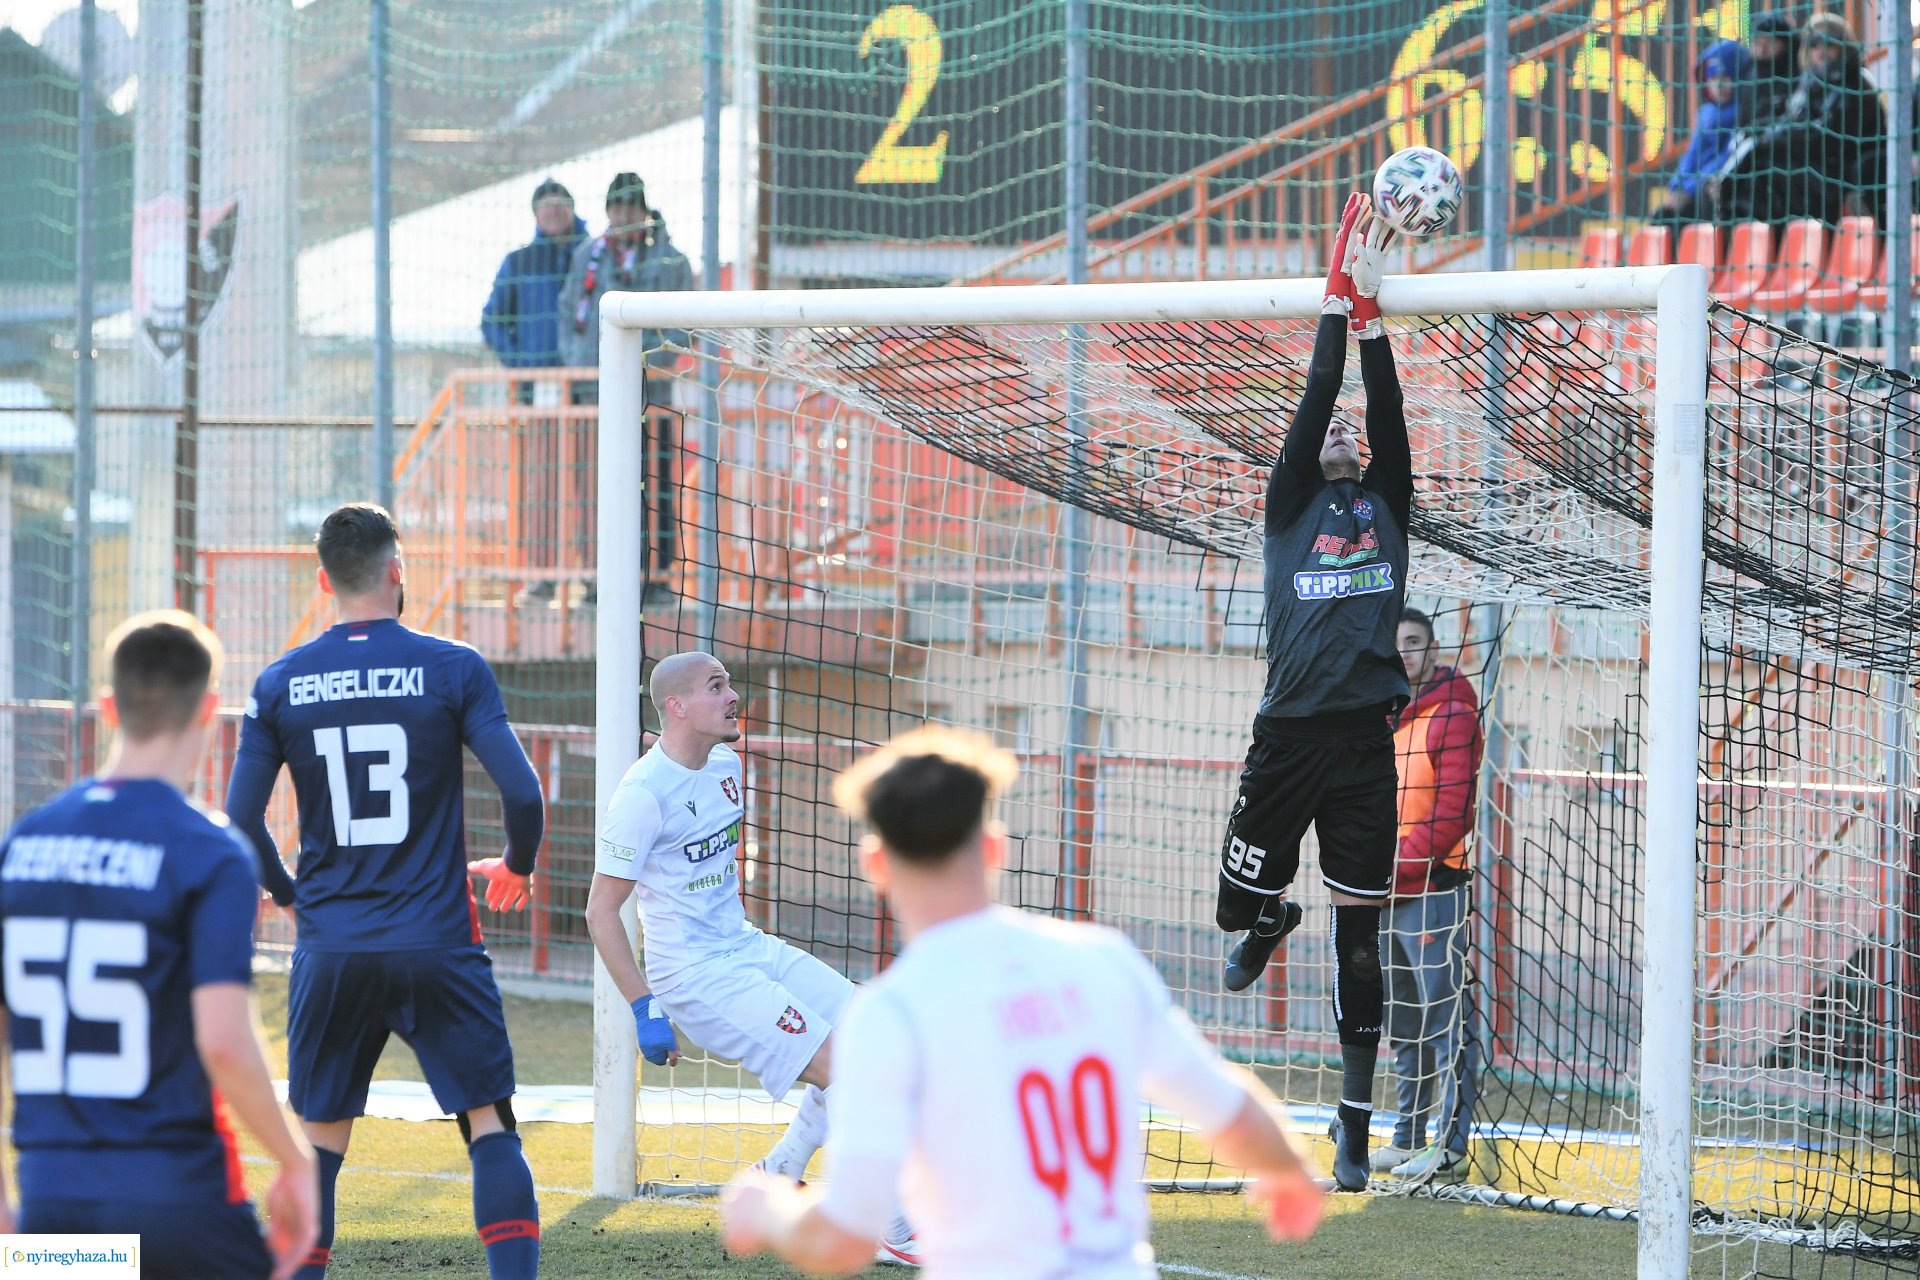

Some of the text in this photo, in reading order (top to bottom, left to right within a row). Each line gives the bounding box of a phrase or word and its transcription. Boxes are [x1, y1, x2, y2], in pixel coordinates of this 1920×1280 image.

[855, 4, 949, 183] 2
[288, 666, 425, 706] GENGELICZKI
[312, 723, 410, 847] 13
[1227, 835, 1267, 880] 95
[2, 916, 152, 1099] 55
